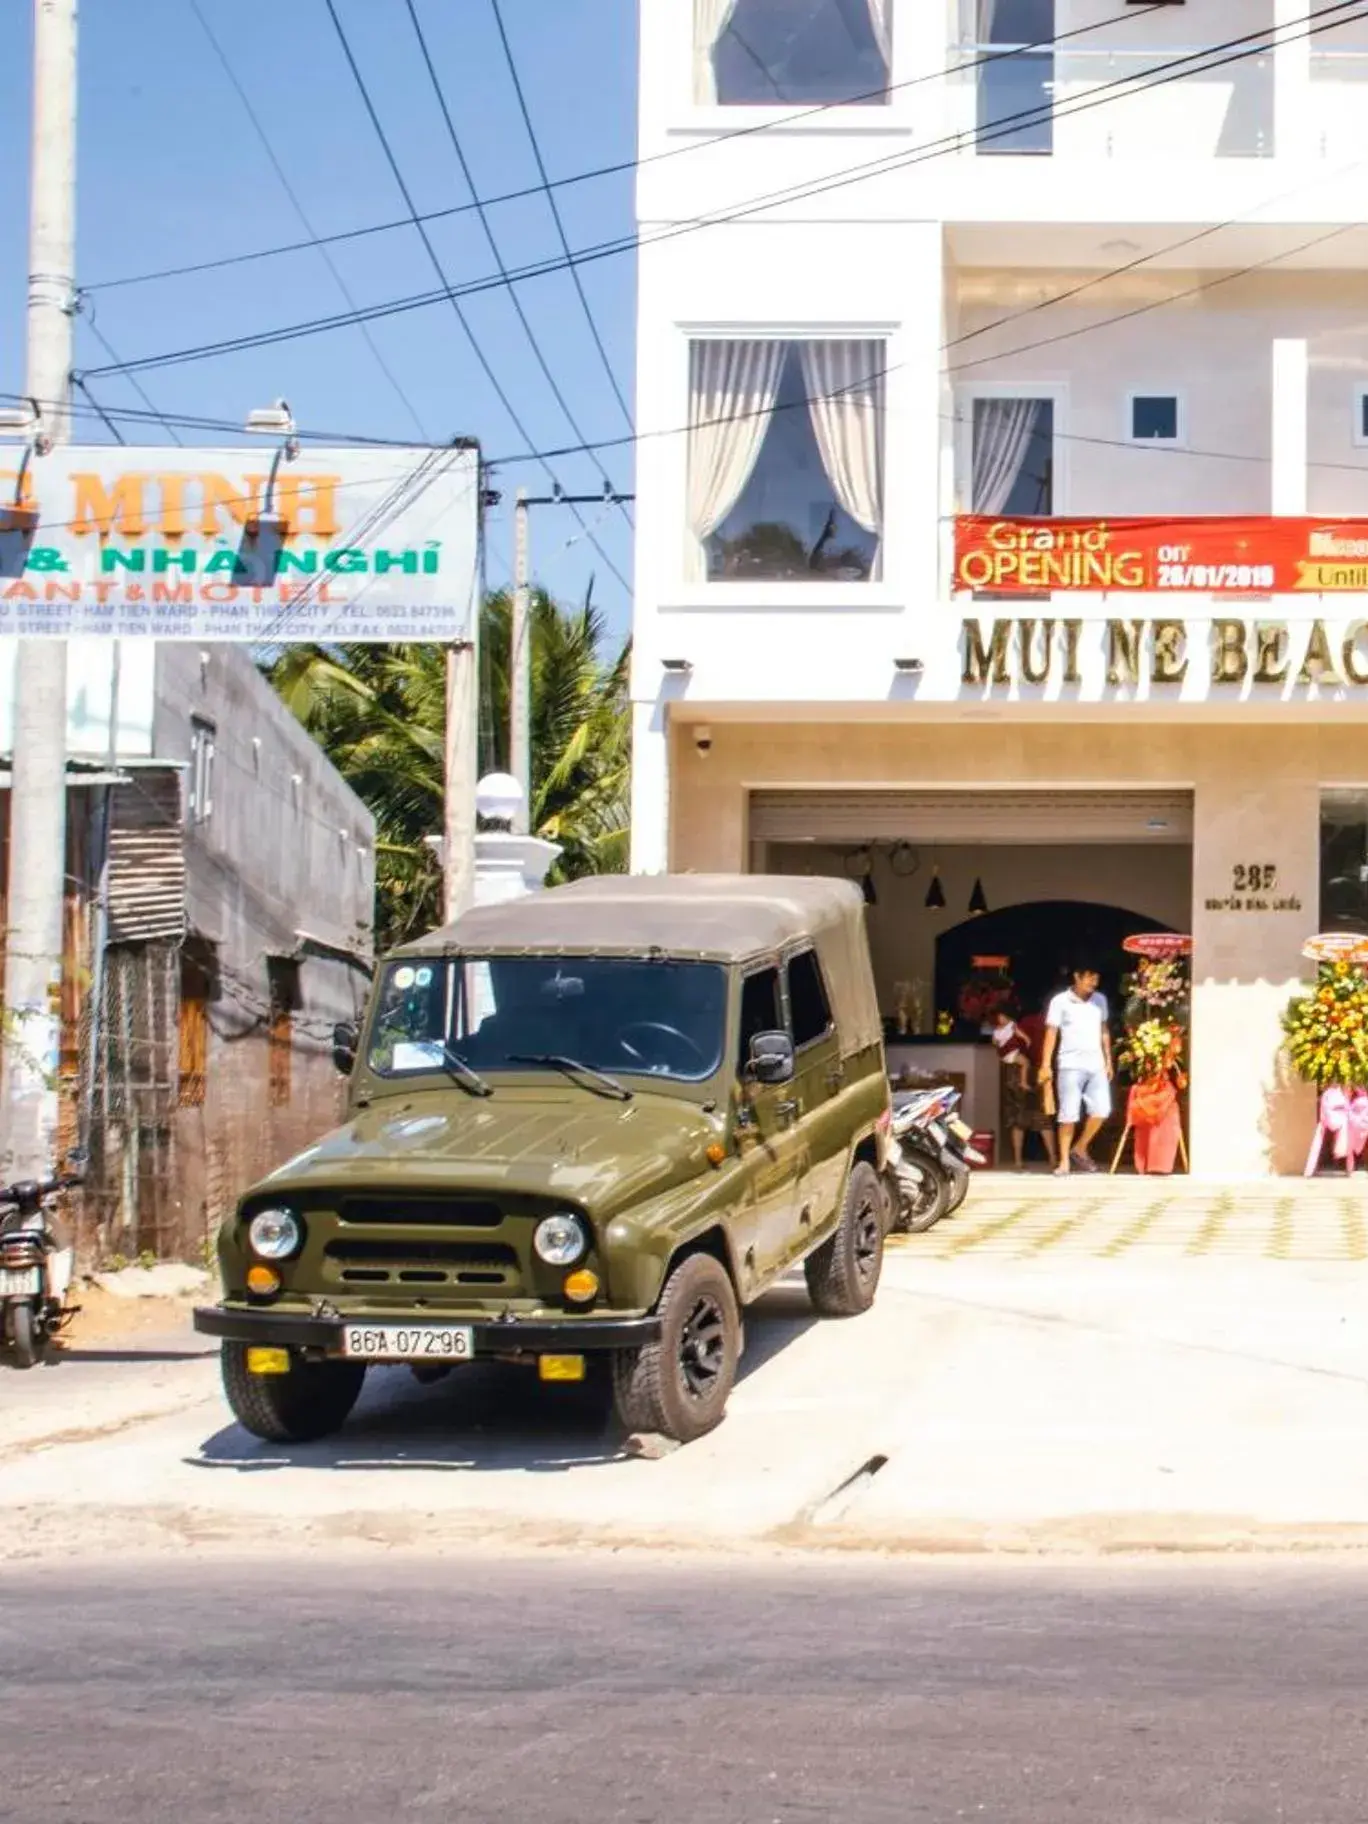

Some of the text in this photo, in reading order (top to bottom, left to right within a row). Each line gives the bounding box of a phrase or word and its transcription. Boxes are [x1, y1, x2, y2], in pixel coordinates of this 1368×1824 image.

[67, 472, 342, 535] MINH
[987, 523, 1109, 550] Grand
[100, 538, 248, 573] NHÀ
[277, 540, 442, 574] NGHỈ
[960, 549, 1144, 587] OPENING
[1318, 566, 1368, 586] Until
[961, 618, 1084, 684] MUI
[1106, 618, 1189, 684] NE
